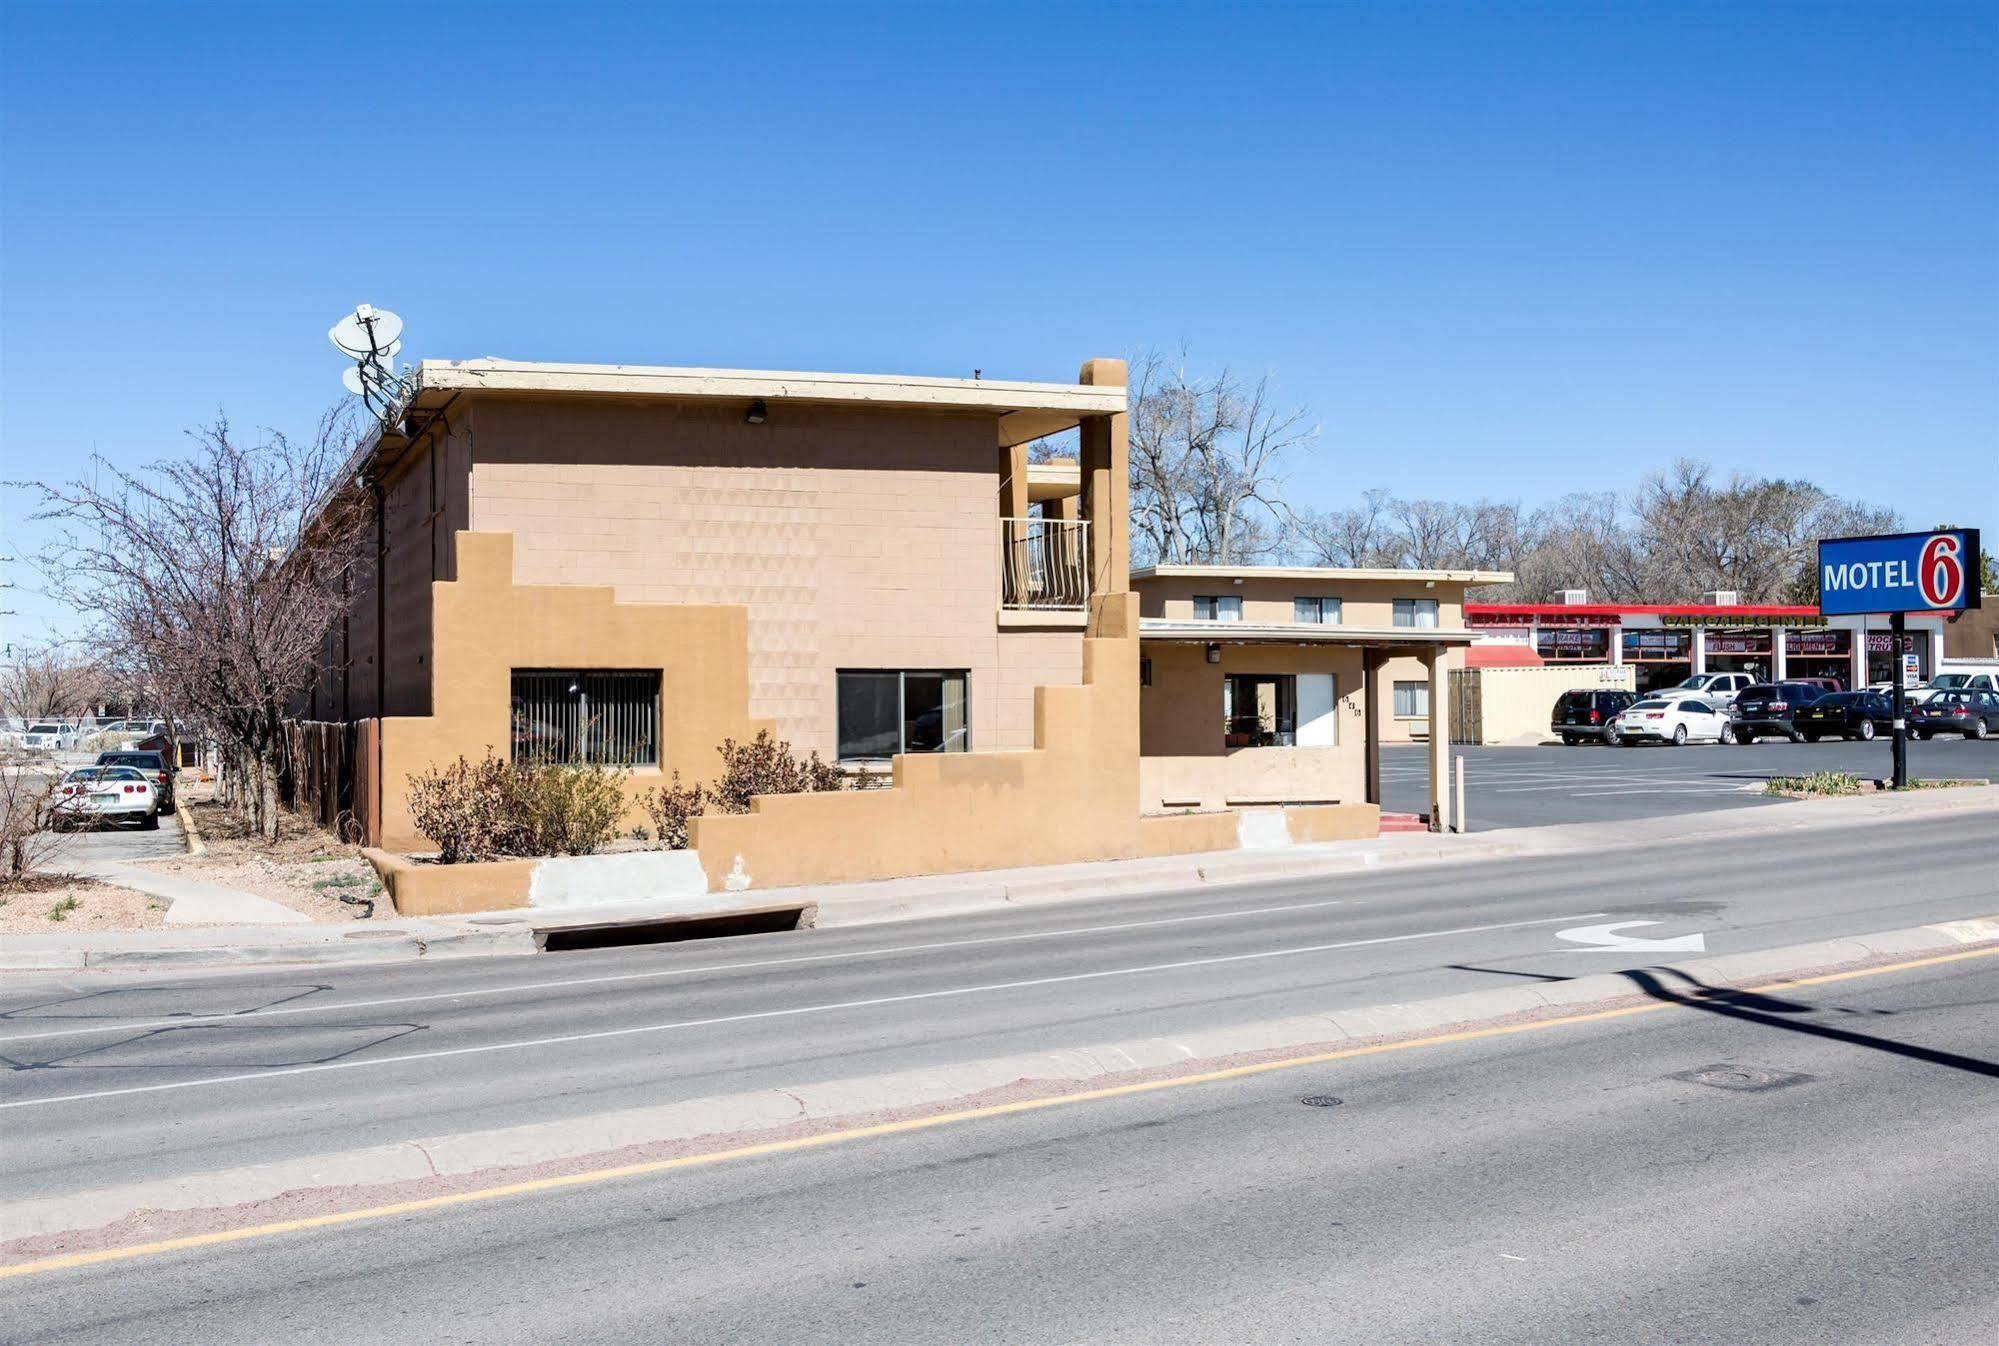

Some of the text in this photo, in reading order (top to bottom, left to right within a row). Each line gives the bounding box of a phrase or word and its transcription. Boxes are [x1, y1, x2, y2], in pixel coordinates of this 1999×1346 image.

[1824, 533, 1965, 608] MOTEL 6
[1471, 613, 1622, 626] BRAKE MASTERS
[1663, 615, 1829, 627] CAR CARE CENTER
